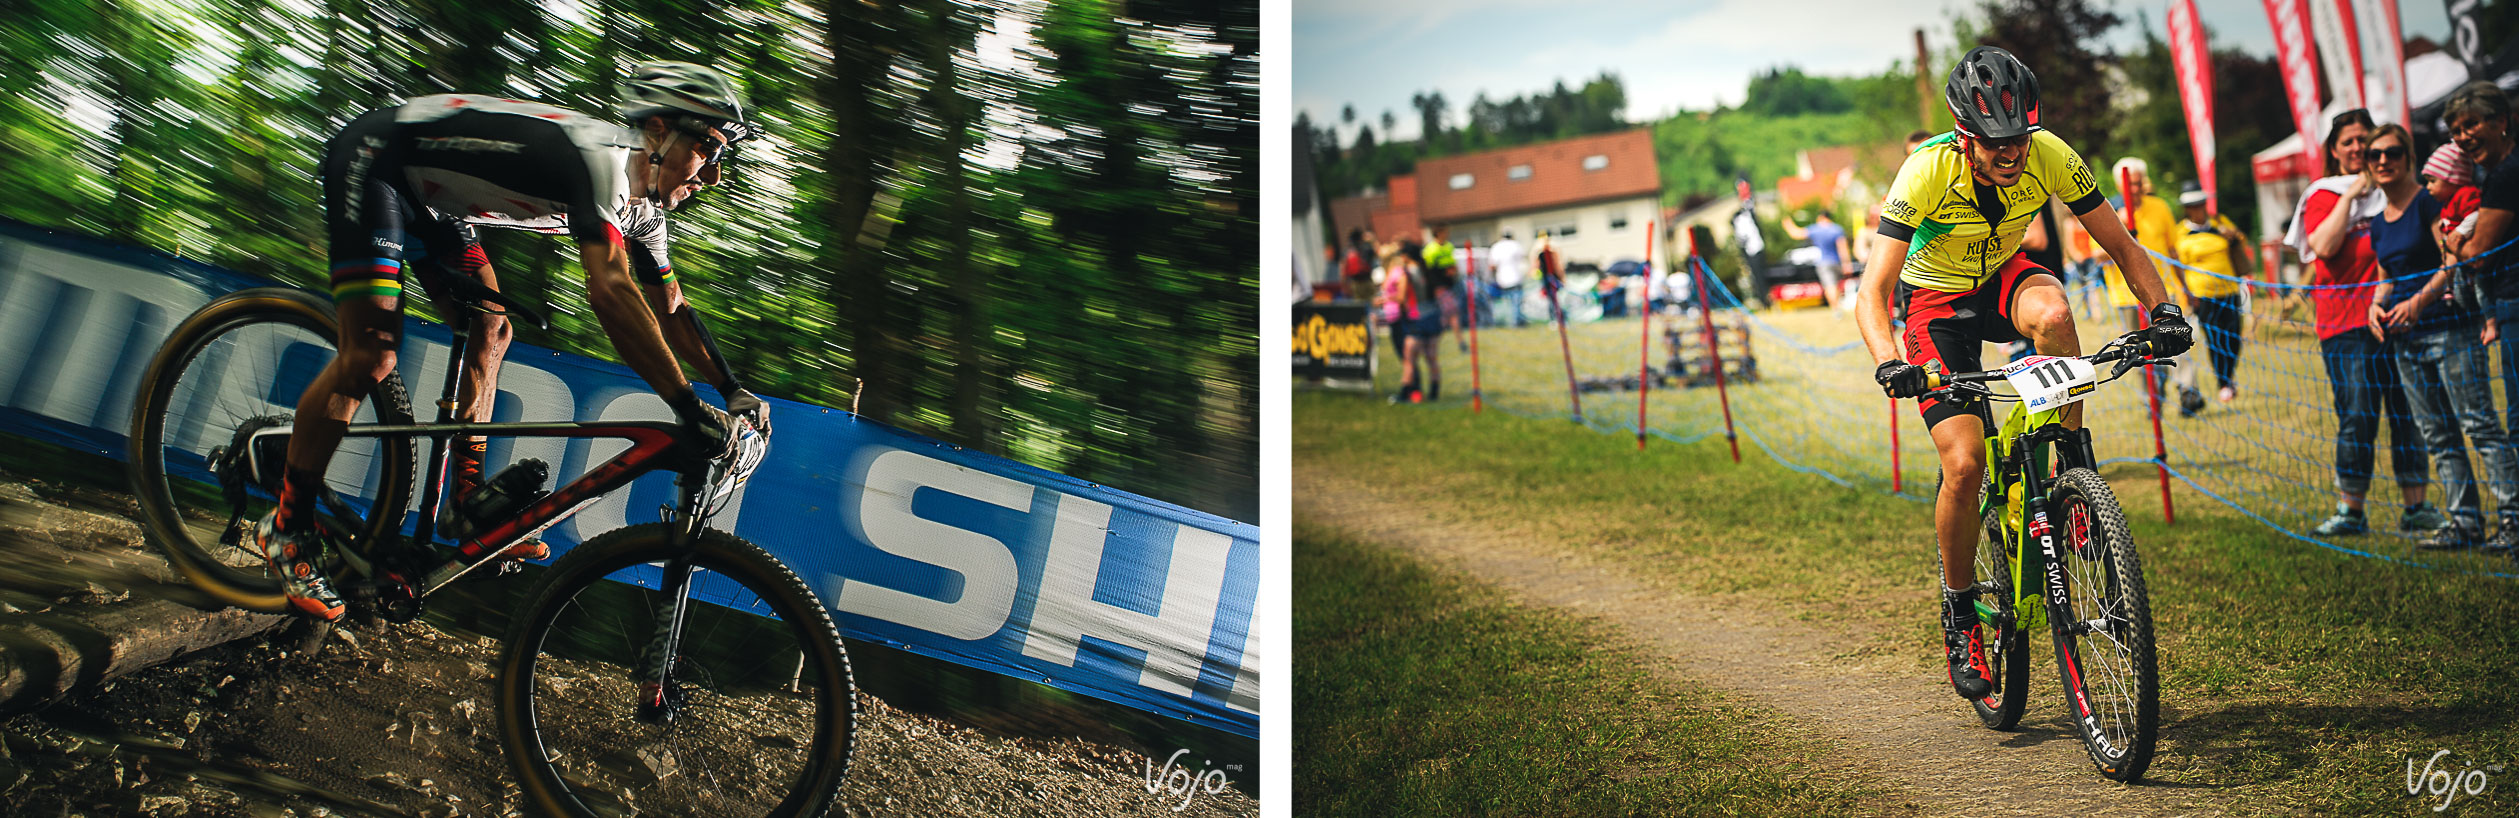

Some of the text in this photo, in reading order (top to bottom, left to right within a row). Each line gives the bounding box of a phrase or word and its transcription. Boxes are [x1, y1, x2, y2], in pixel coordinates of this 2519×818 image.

[2010, 185, 2034, 201] ORE
[1892, 198, 1918, 216] ultra
[1938, 210, 1980, 220] DT SWISS
[2006, 363, 2026, 374] UCI
[2030, 360, 2076, 389] 111
[2041, 535, 2056, 558] DT
[2047, 562, 2067, 605] SWISS
